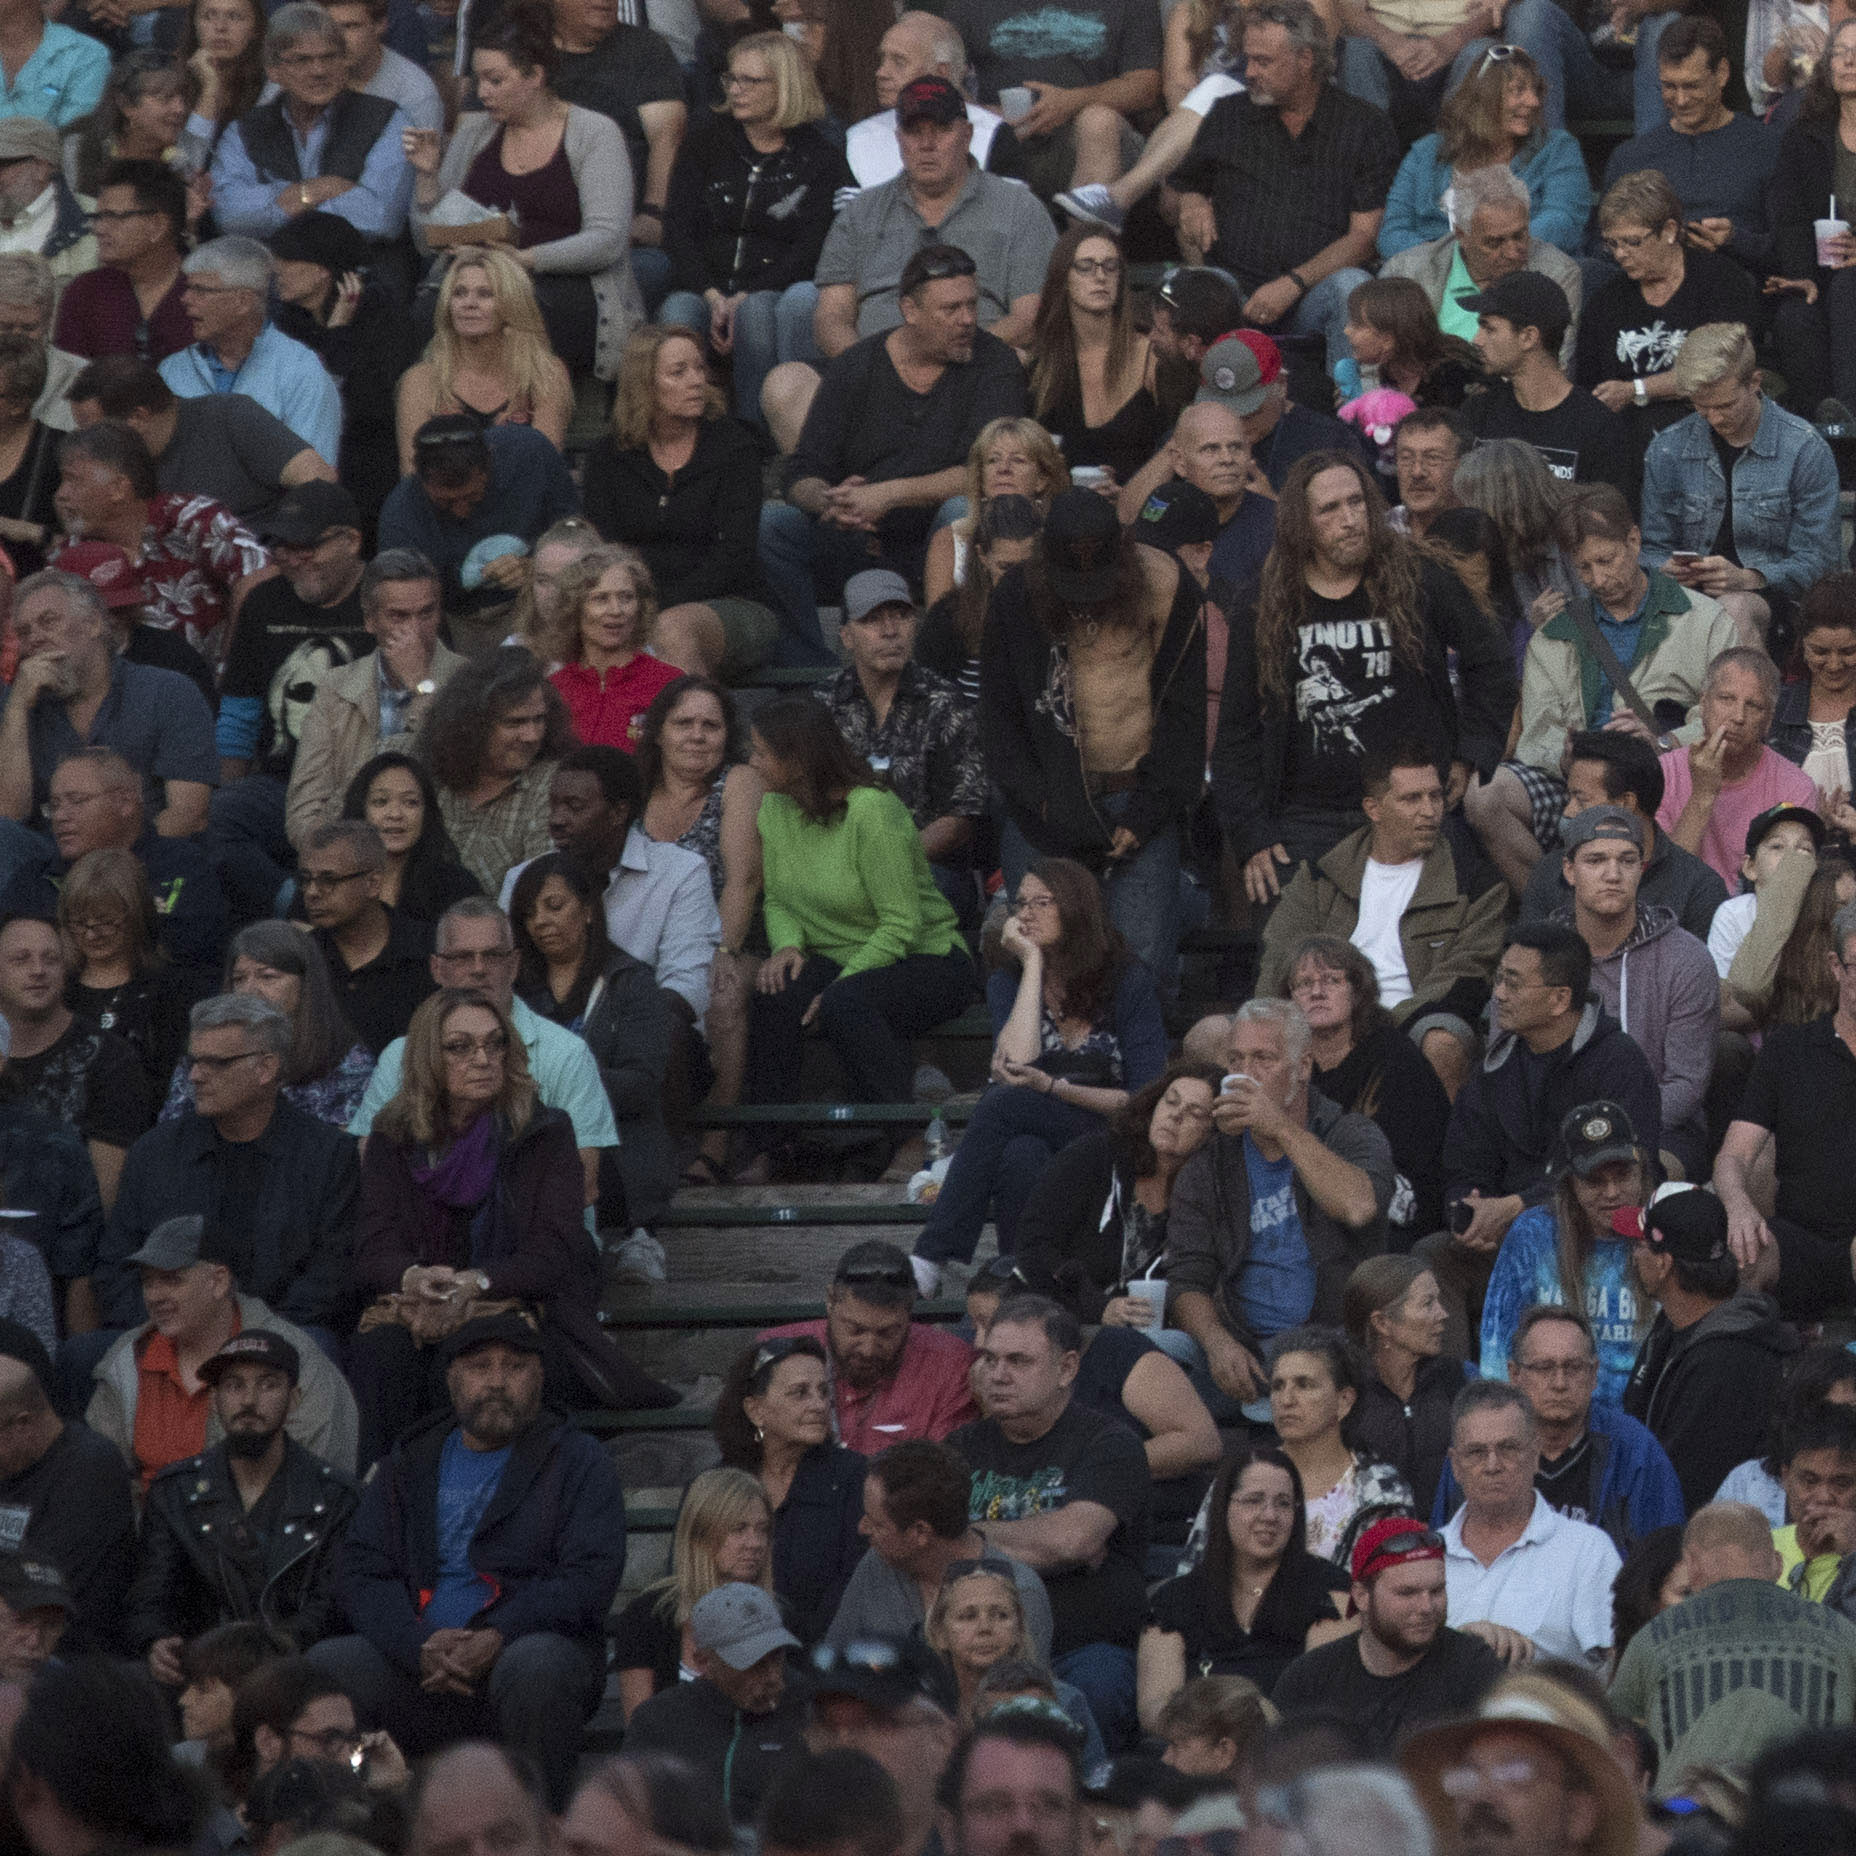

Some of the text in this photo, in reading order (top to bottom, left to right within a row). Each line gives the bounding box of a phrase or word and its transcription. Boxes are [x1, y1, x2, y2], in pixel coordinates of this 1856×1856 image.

[1298, 618, 1392, 650] YNOTT
[835, 1108, 847, 1120] 11
[778, 1209, 791, 1220] 11
